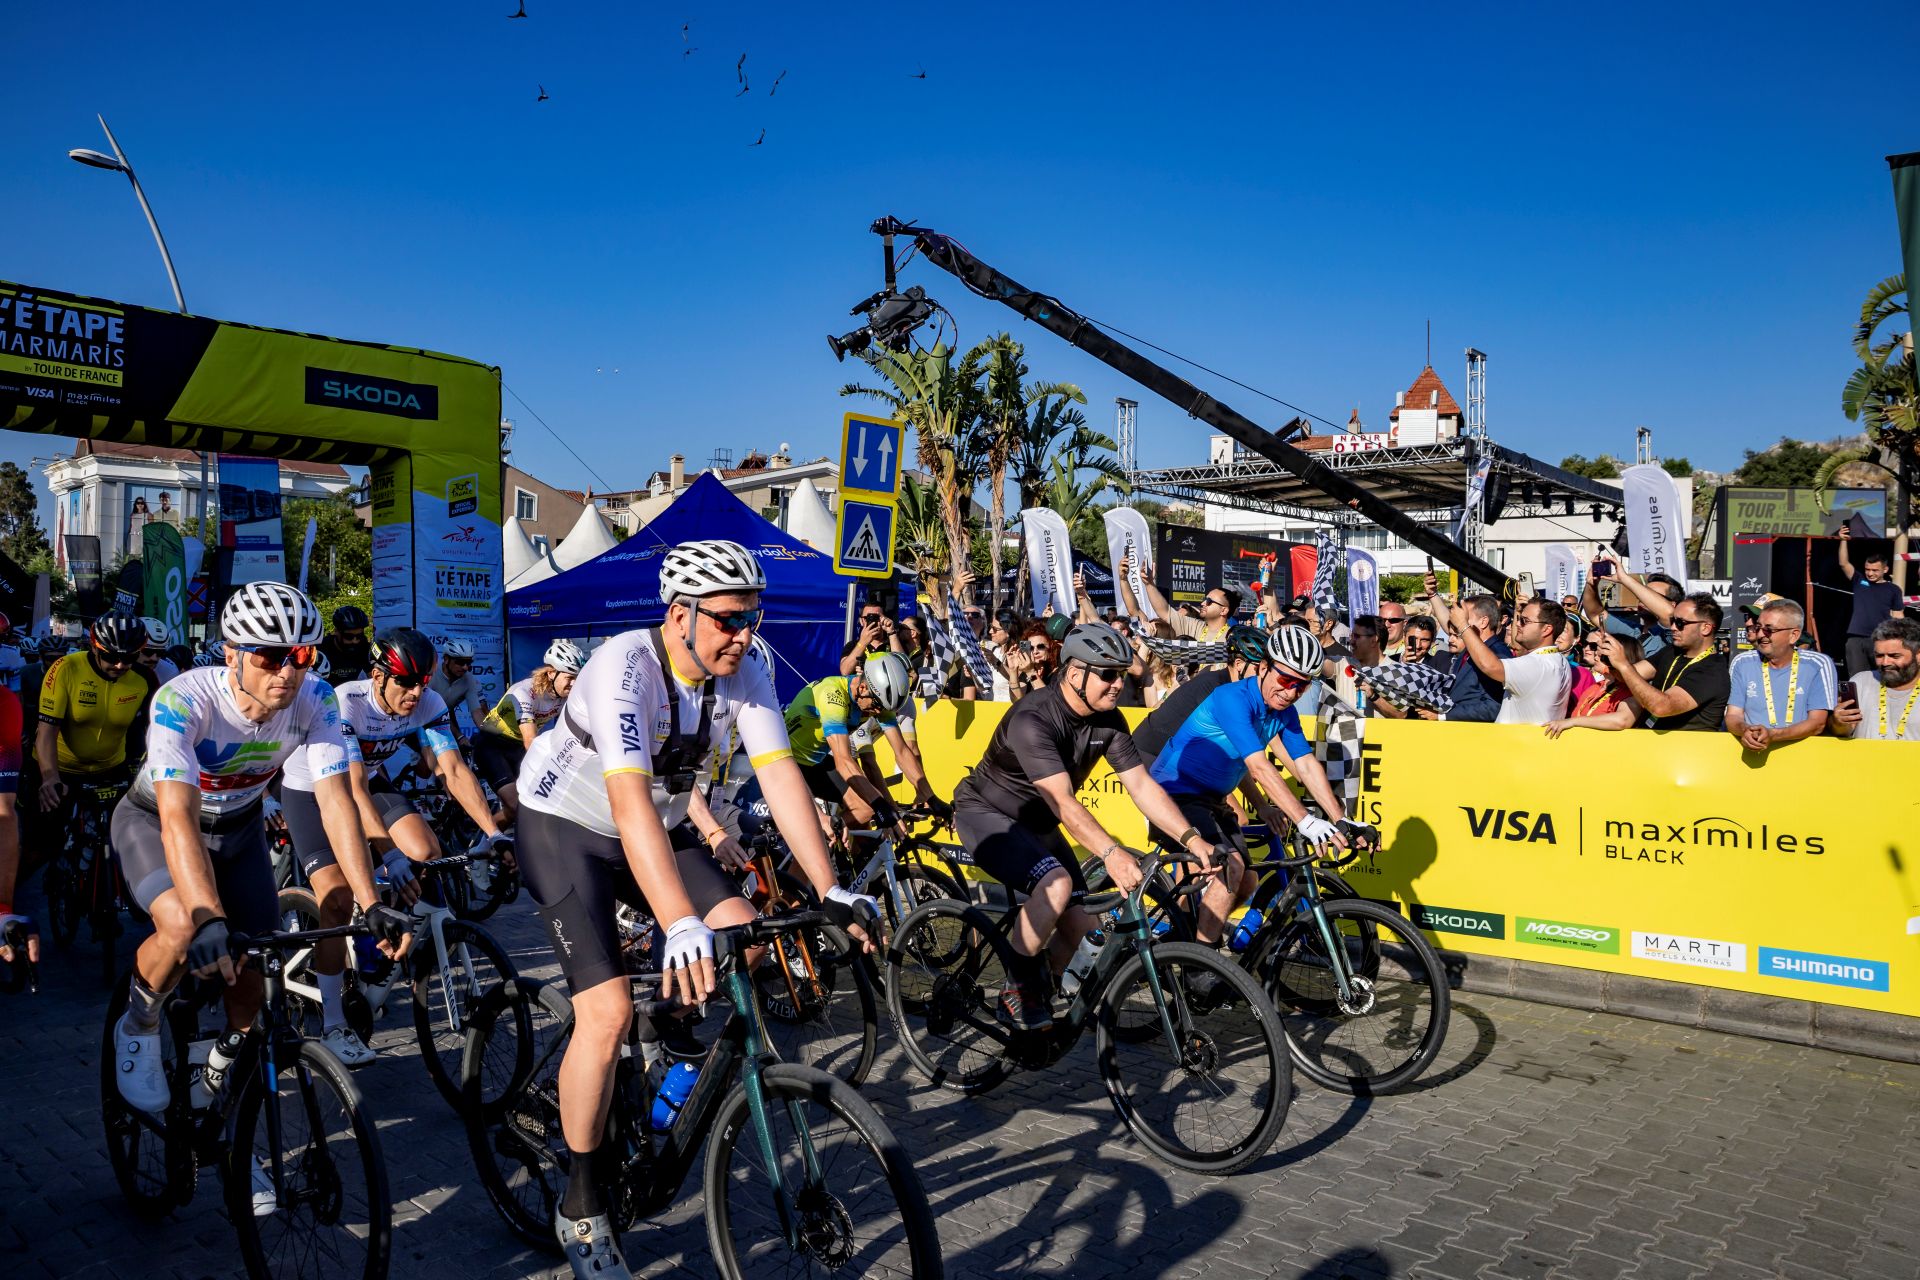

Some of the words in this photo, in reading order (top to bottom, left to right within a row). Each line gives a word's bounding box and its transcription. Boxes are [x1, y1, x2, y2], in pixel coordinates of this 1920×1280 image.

[0, 292, 124, 344] 'ÉTAPE
[33, 363, 62, 376] TOUR
[65, 367, 77, 378] DE
[80, 370, 118, 383] FRANCE
[25, 386, 55, 399] VISA
[67, 392, 121, 404] maximiles
[323, 381, 421, 410] SKODA
[1737, 502, 1776, 520] TOUR
[1743, 520, 1754, 530] DE
[1754, 522, 1811, 536] FRANCE
[436, 566, 491, 588] L'ÉTAPE
[1172, 560, 1206, 581] L'ÉTAPE
[436, 588, 491, 600] MARMARİS
[639, 598, 655, 608] Kolay
[46, 656, 65, 690] Asperox
[633, 671, 644, 695] BLACK
[619, 713, 642, 755] VISA
[97, 790, 118, 800] 1217
[534, 770, 559, 799] VISA
[1458, 806, 1557, 845] VISA
[1605, 817, 1825, 855] maximiles
[1605, 844, 1685, 865] BLACK
[1421, 912, 1493, 931] SKODA
[1525, 922, 1611, 941] MOSSO
[1645, 935, 1731, 958] MARTI
[1771, 956, 1875, 982] SHIMANO
[1536, 936, 1578, 946] HAREKETE
[1645, 951, 1679, 961] HOTELS
[1689, 956, 1732, 967] MARINAS
